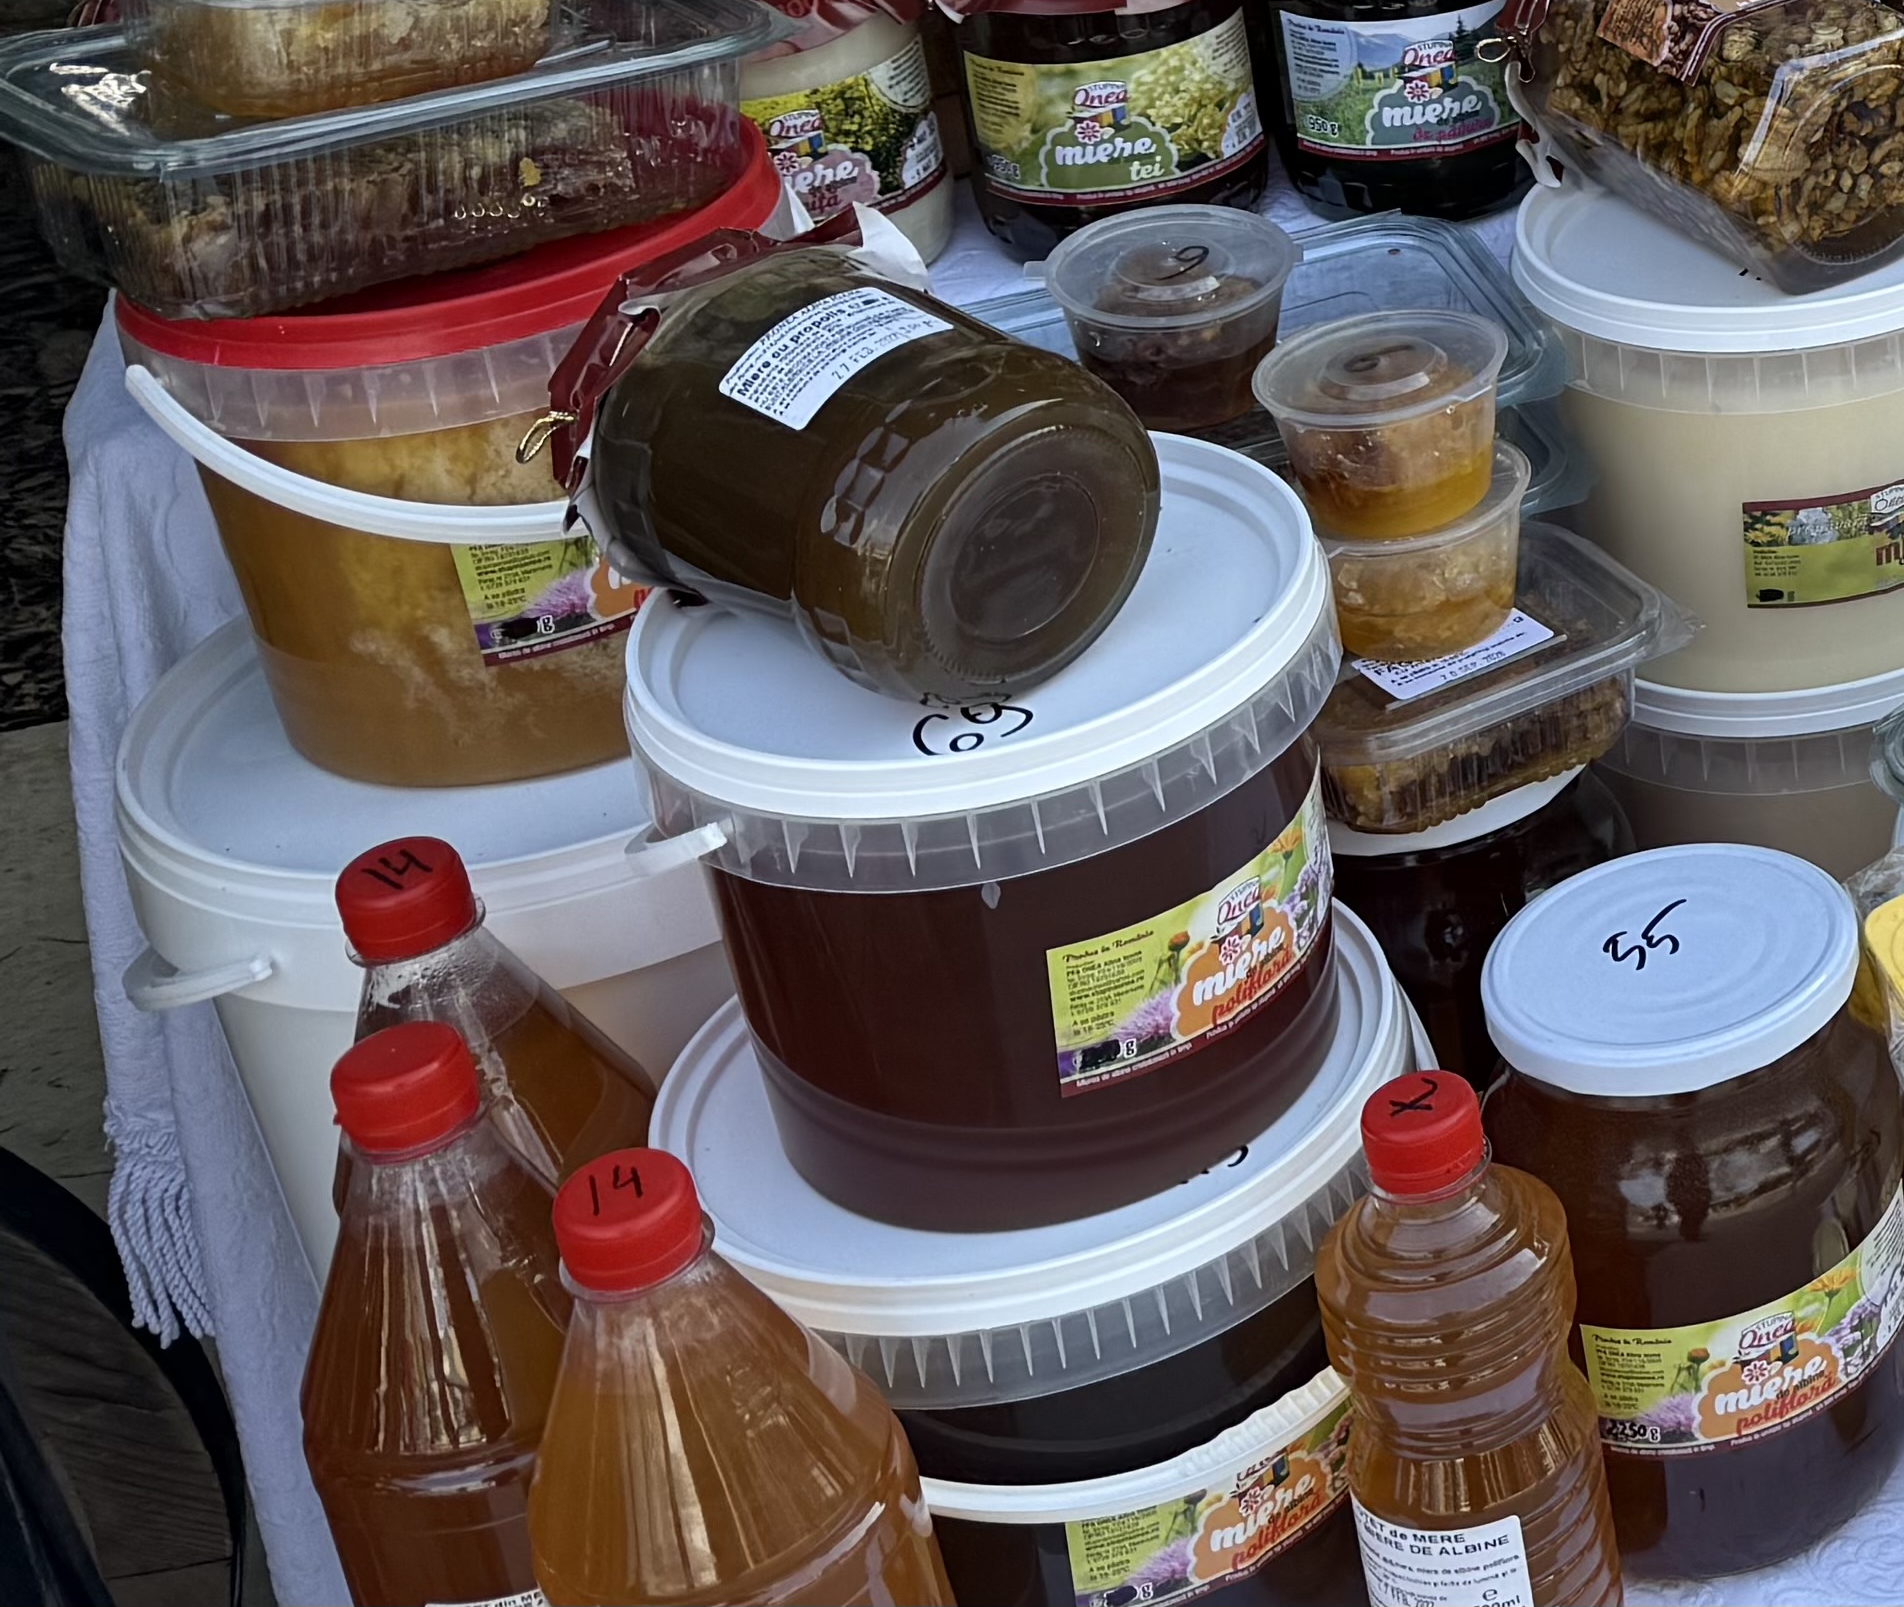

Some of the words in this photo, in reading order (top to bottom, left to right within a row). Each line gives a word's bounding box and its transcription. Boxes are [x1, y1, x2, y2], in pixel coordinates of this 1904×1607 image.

[1382, 94, 1482, 129] miere
[1055, 137, 1156, 167] miere
[1130, 160, 1165, 181] tei
[791, 307, 847, 349] propolis
[1192, 926, 1286, 1006] miere
[588, 1164, 645, 1215] 14
[1714, 1356, 1828, 1416] miere
[1736, 1376, 1837, 1436] polifloră
[1209, 1472, 1317, 1555] miere
[1409, 1543, 1434, 1556] DE
[1436, 1536, 1510, 1557] ALBINE
[1412, 1531, 1464, 1546] MERE
